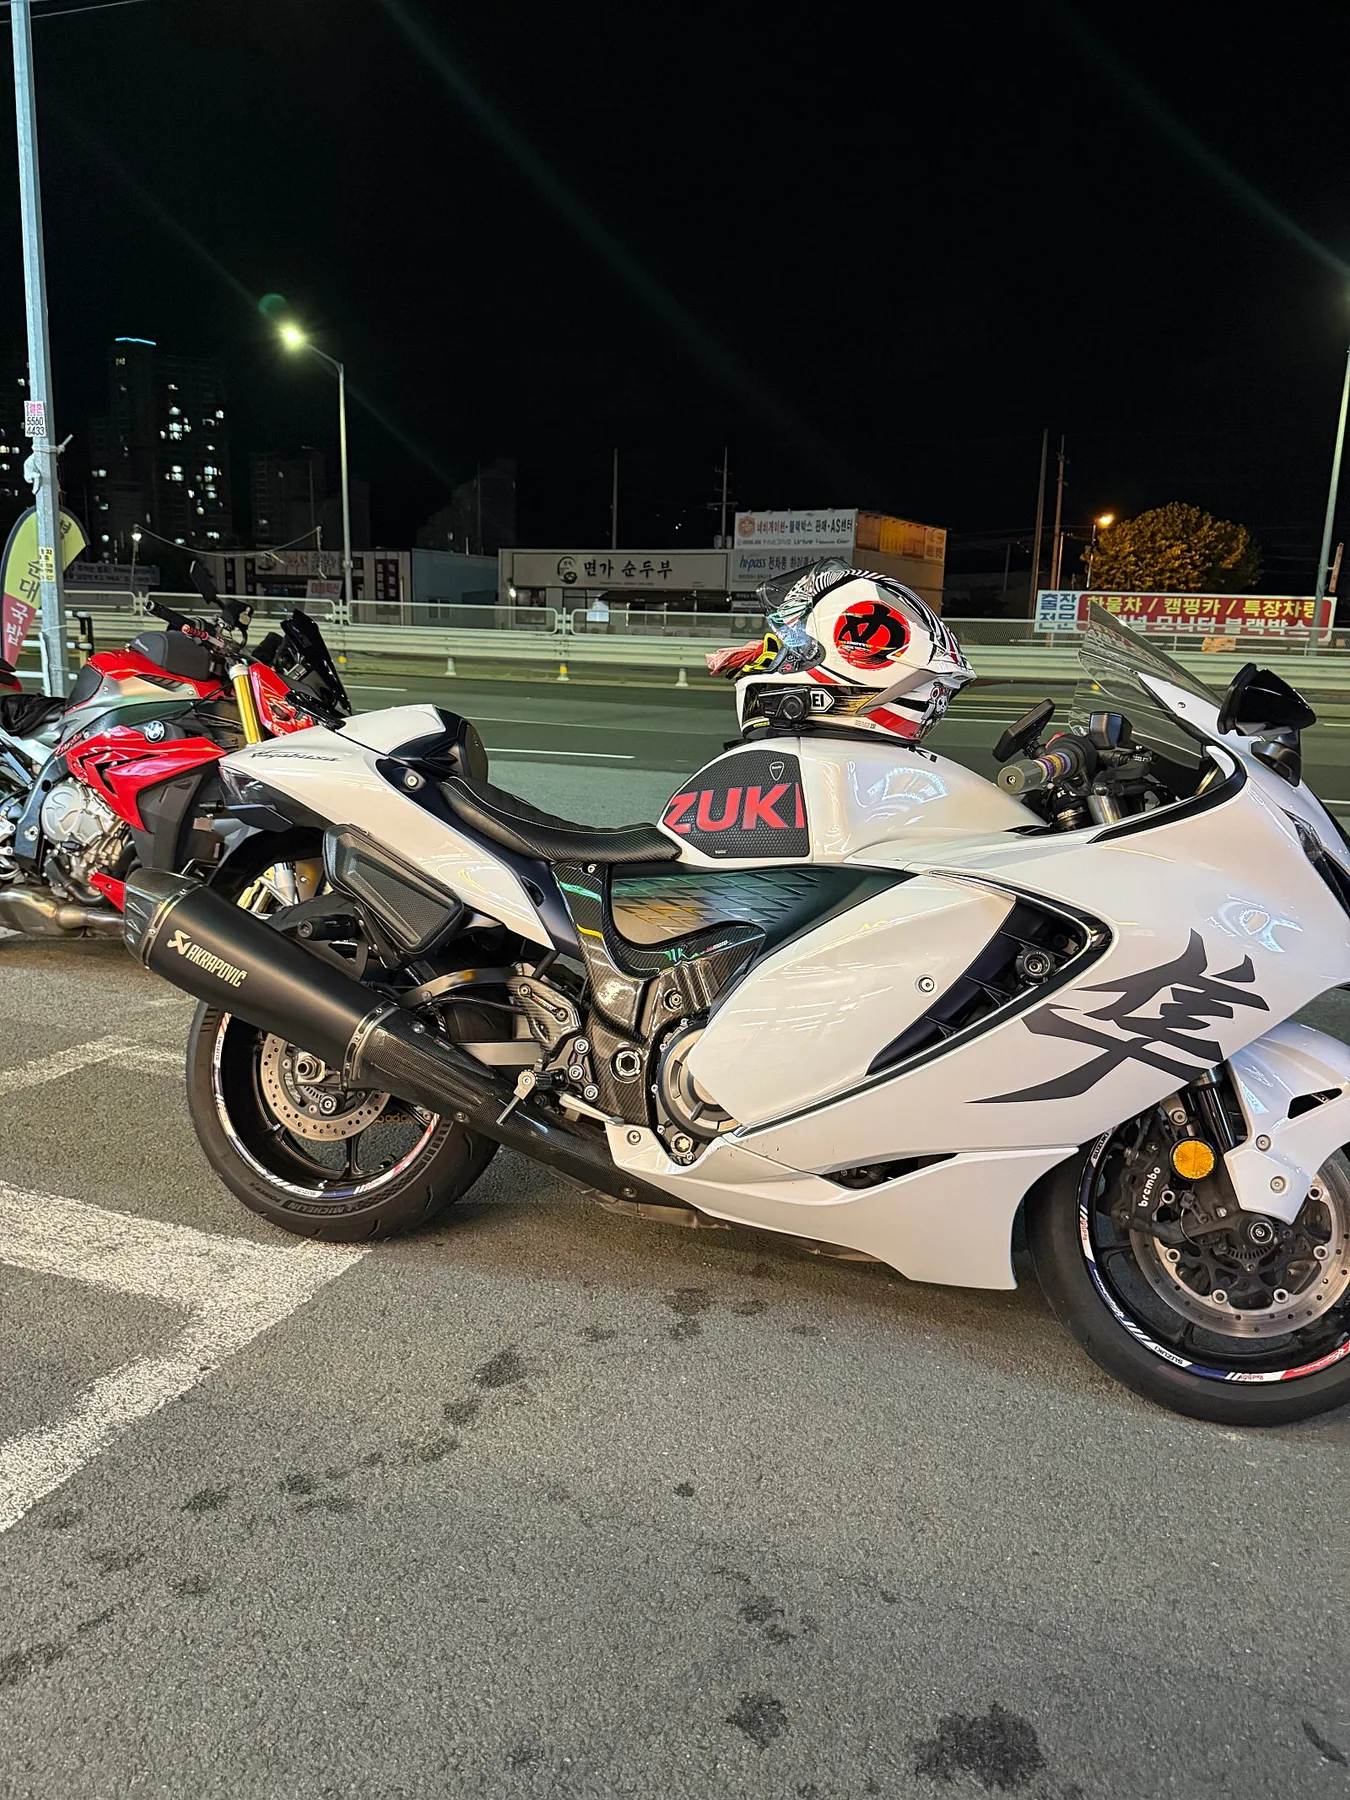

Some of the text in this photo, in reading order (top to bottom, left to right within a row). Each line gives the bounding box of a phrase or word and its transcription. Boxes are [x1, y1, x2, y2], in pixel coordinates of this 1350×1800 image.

[26, 426, 45, 436] 4433
[584, 560, 614, 580] 면가
[621, 559, 673, 580] 순두부
[1041, 593, 1077, 611] 출장
[1164, 597, 1220, 615] 캠핑카
[1038, 612, 1076, 631] 전문
[1153, 615, 1216, 634] 모니터
[1137, 1166, 1162, 1208] brembo
